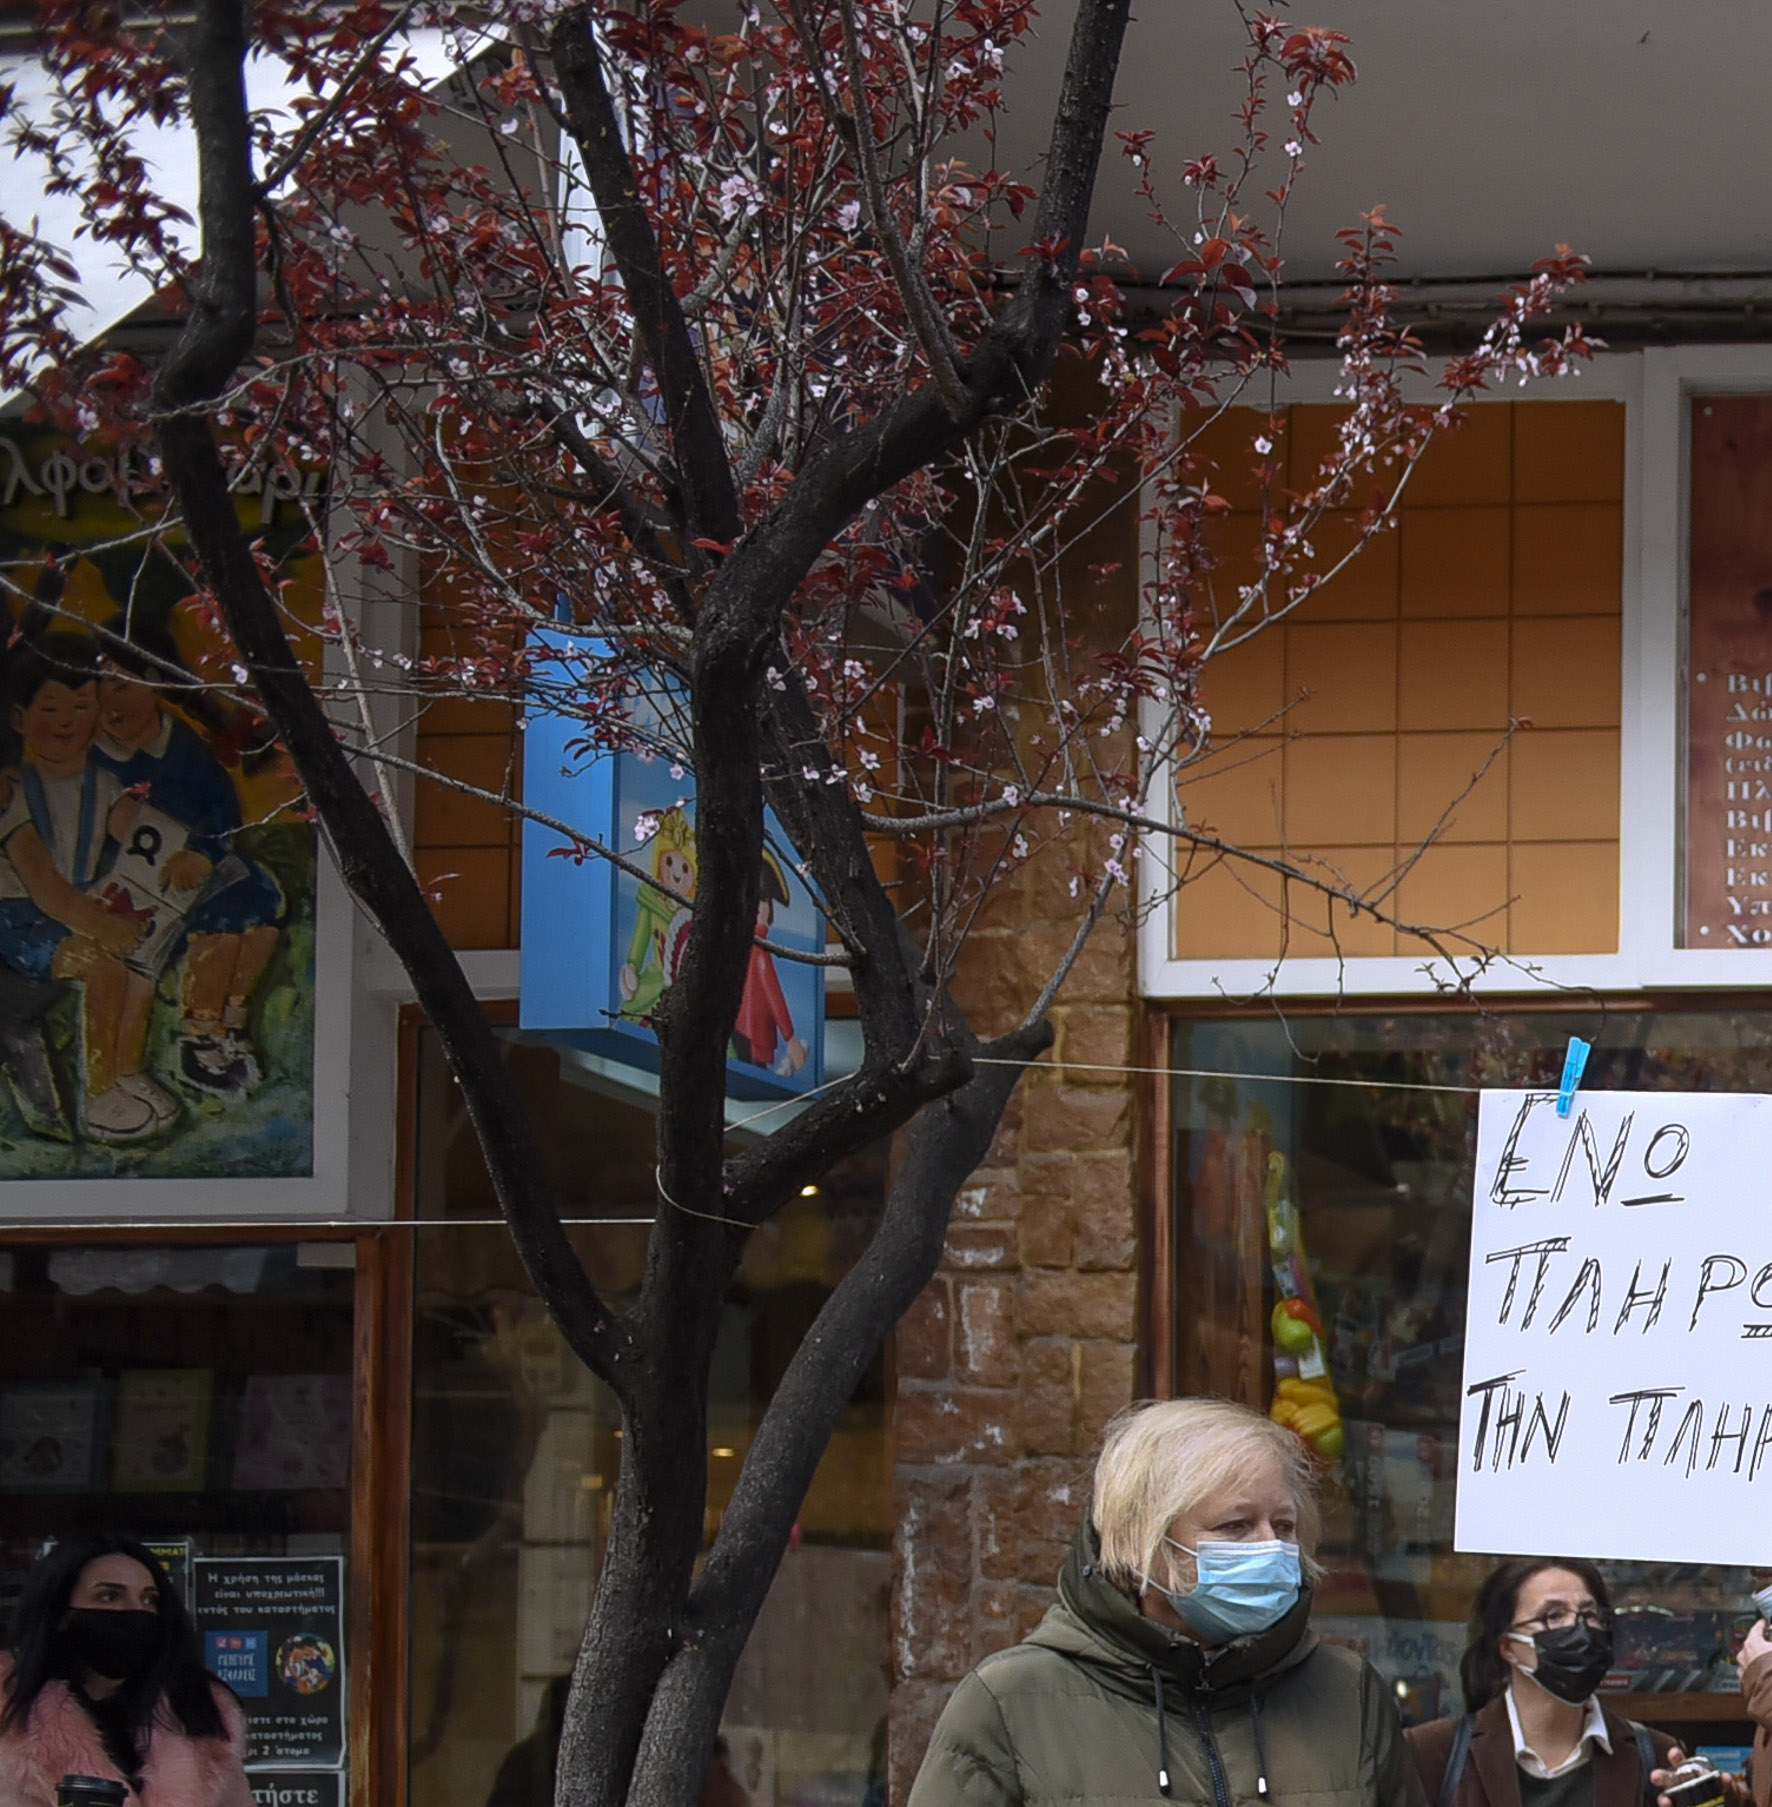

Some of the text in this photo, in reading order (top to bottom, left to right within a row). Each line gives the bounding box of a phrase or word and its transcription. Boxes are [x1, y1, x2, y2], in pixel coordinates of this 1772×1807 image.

[1466, 1369, 1571, 1474] ΤΗΝ
[207, 1571, 325, 1586] Η χρήση της μάσκας
[246, 1729, 323, 1743] αταστήματος
[262, 1744, 271, 1756] 2
[251, 1782, 319, 1807] τήστε
